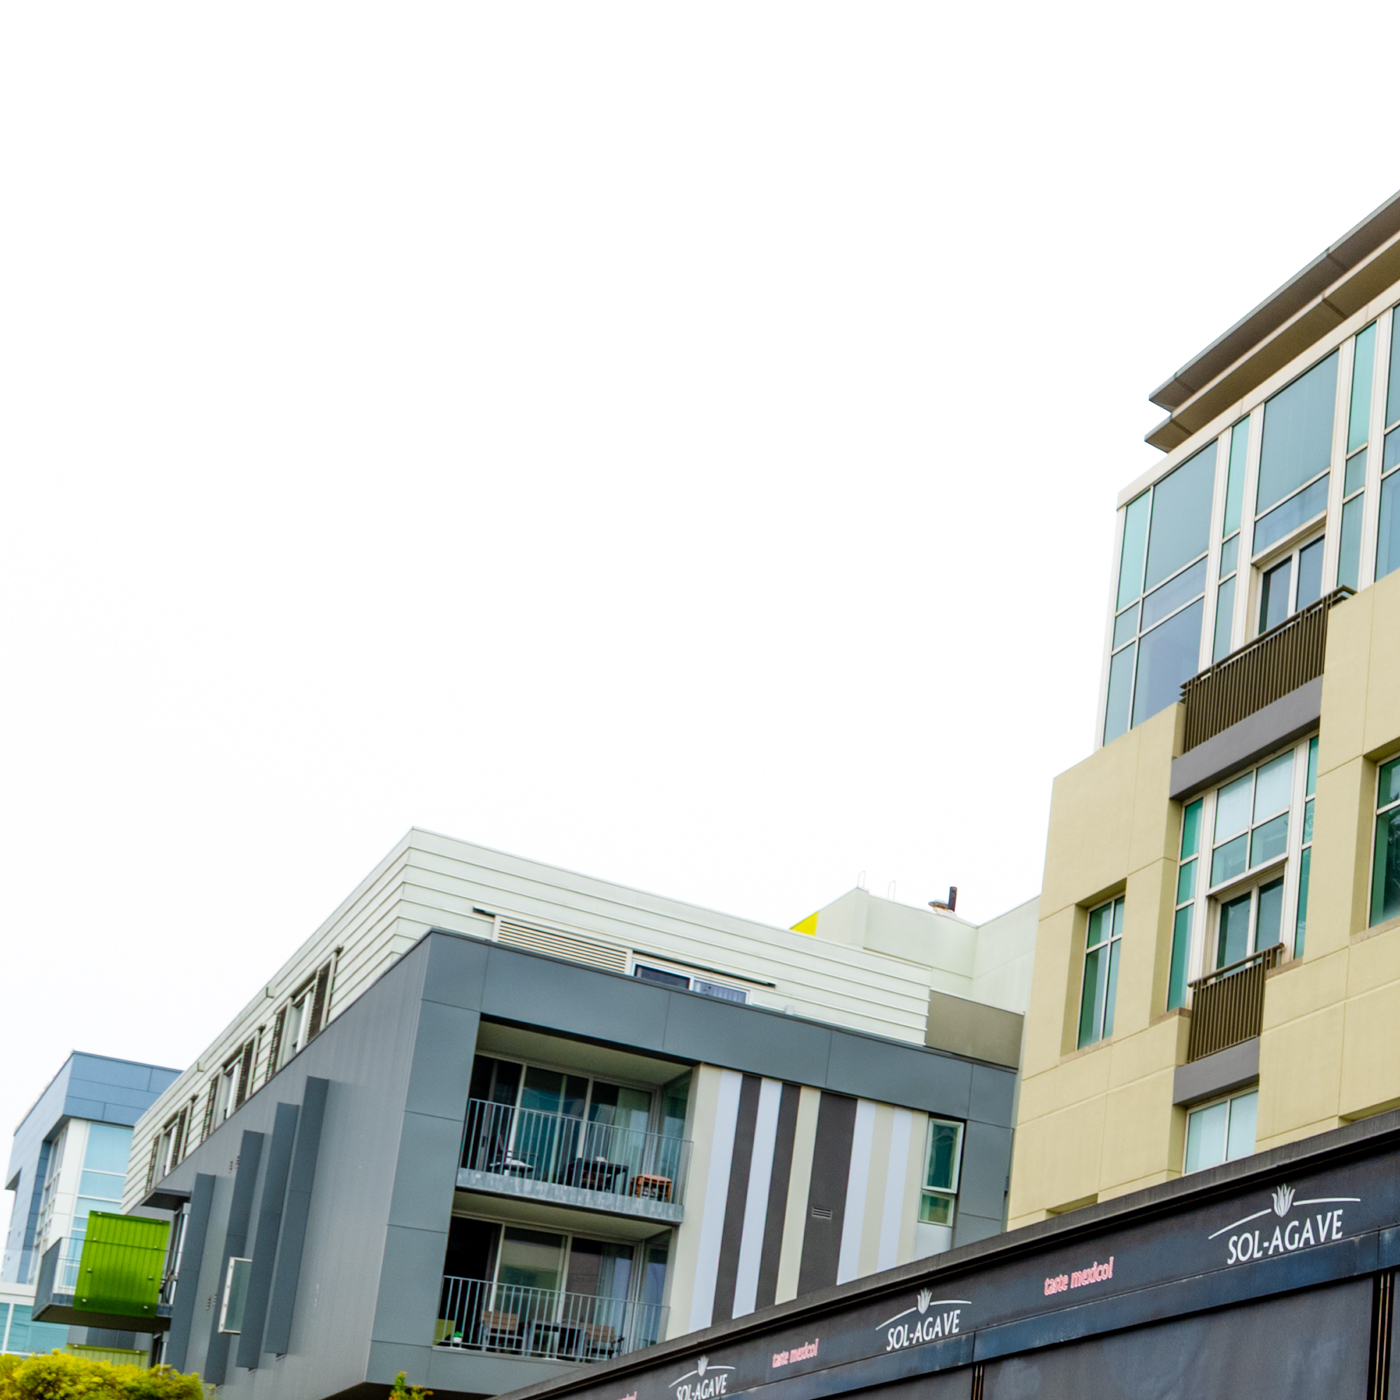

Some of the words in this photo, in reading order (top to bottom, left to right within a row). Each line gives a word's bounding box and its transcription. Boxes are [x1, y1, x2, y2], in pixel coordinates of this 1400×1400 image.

[1227, 1208, 1343, 1265] SOL-AGAVE
[1044, 1273, 1069, 1296] taste
[1070, 1256, 1114, 1289] mexico!
[886, 1308, 961, 1352] SOL-AGAVE
